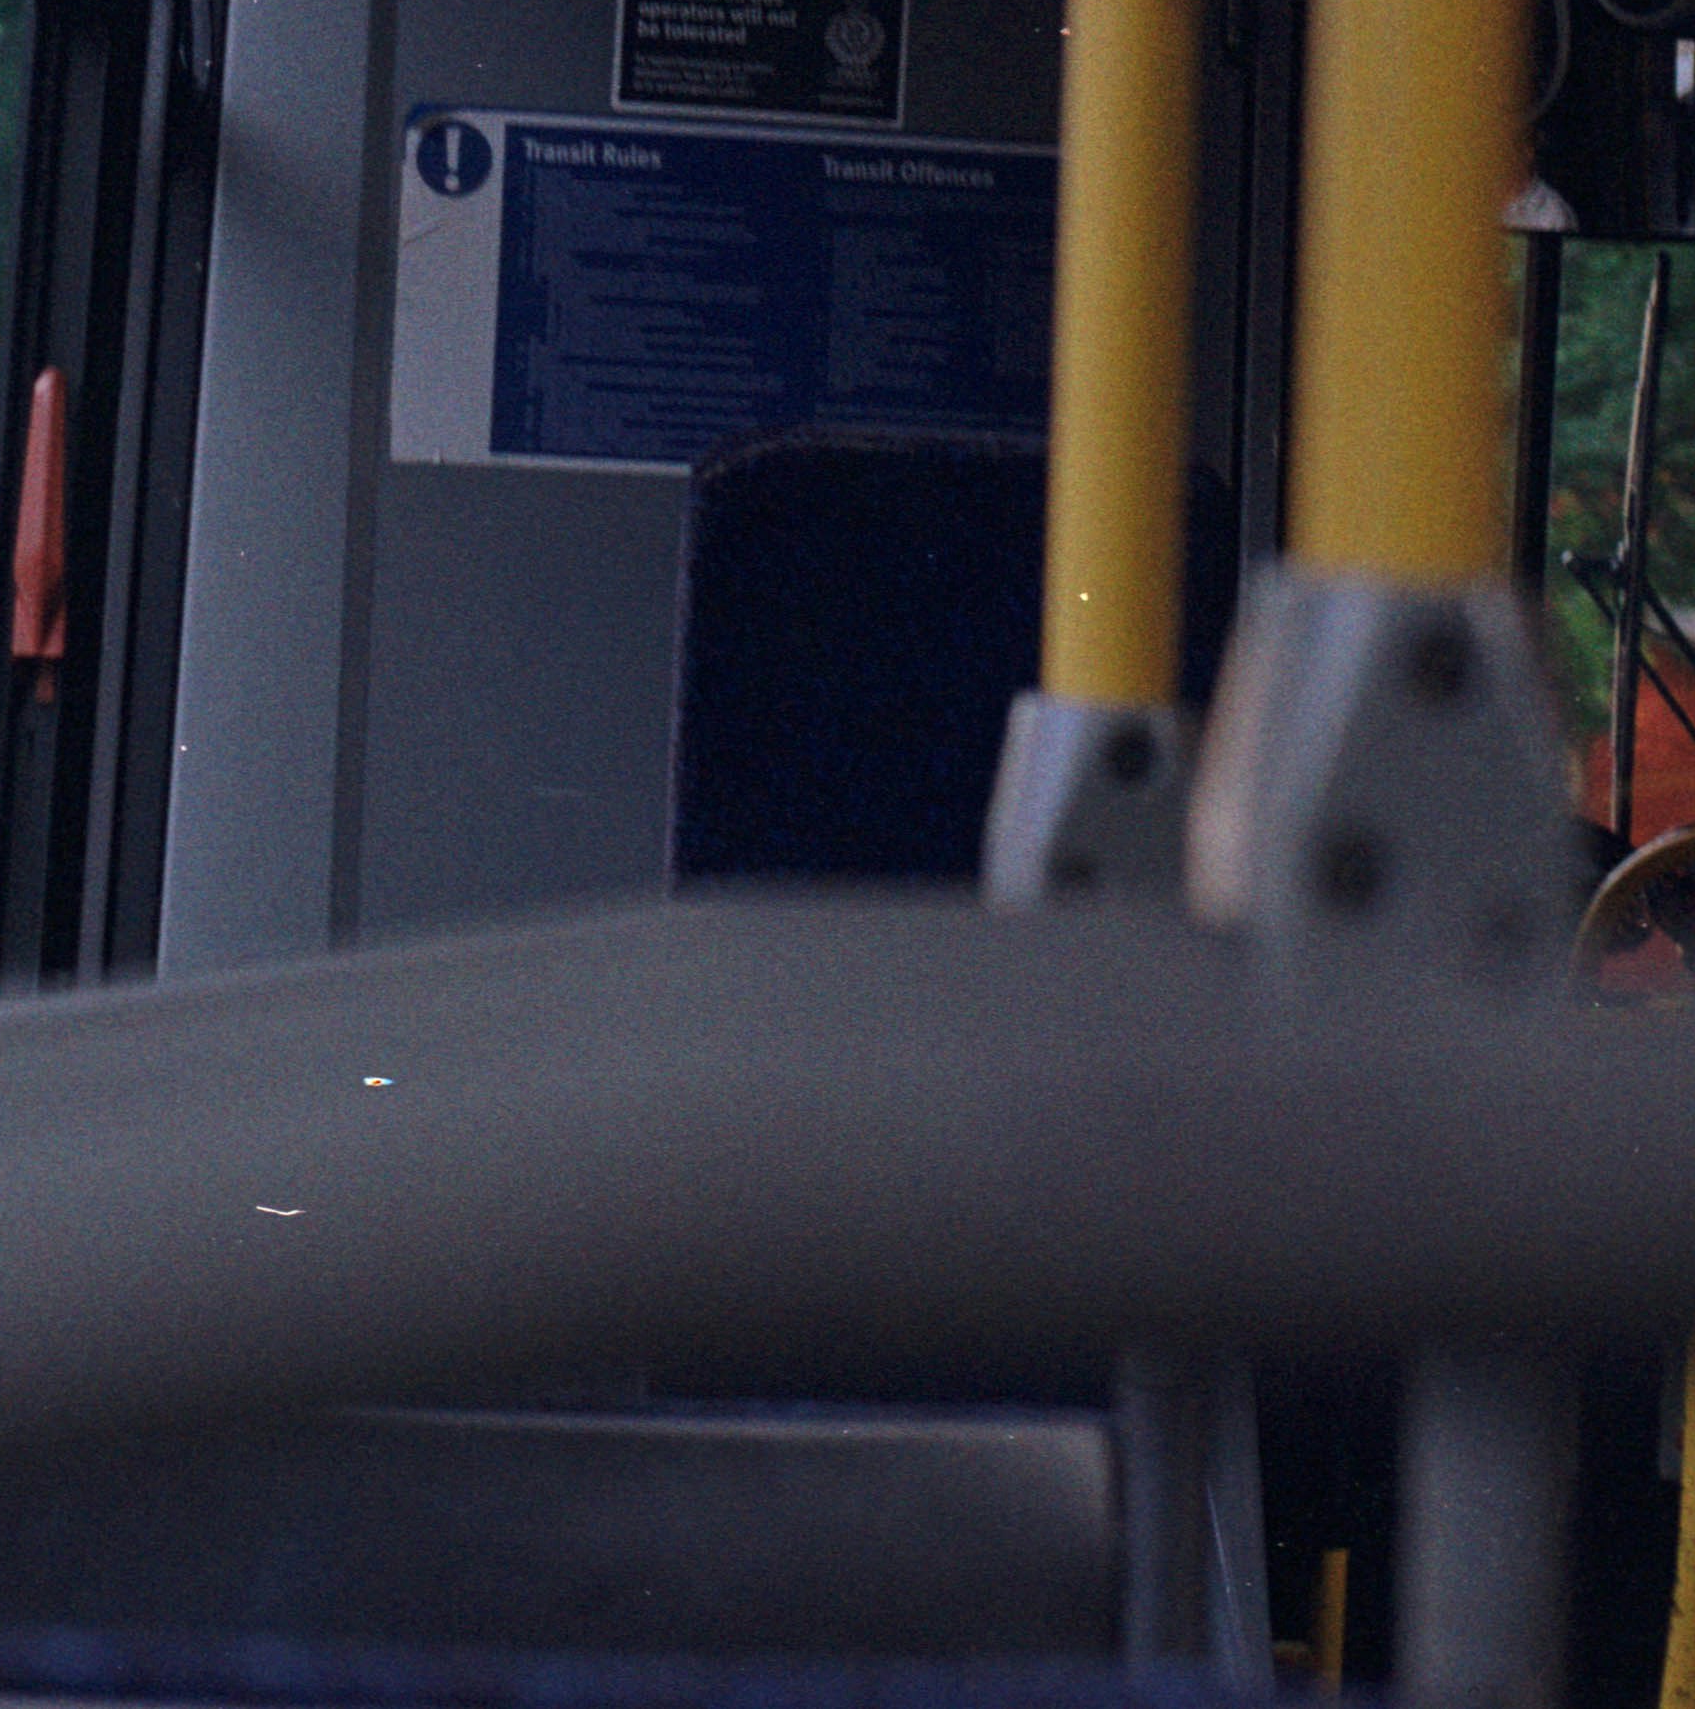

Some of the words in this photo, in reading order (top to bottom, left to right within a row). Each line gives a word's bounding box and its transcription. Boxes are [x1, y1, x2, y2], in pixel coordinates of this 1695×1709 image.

[637, 1, 725, 23] operators
[730, 5, 762, 26] will
[767, 9, 797, 29] not
[636, 20, 659, 39] be
[664, 23, 747, 45] tolerated
[522, 138, 595, 166] Transit
[602, 144, 662, 171] Rules
[823, 155, 897, 184] Transit
[903, 159, 995, 189] Offences
